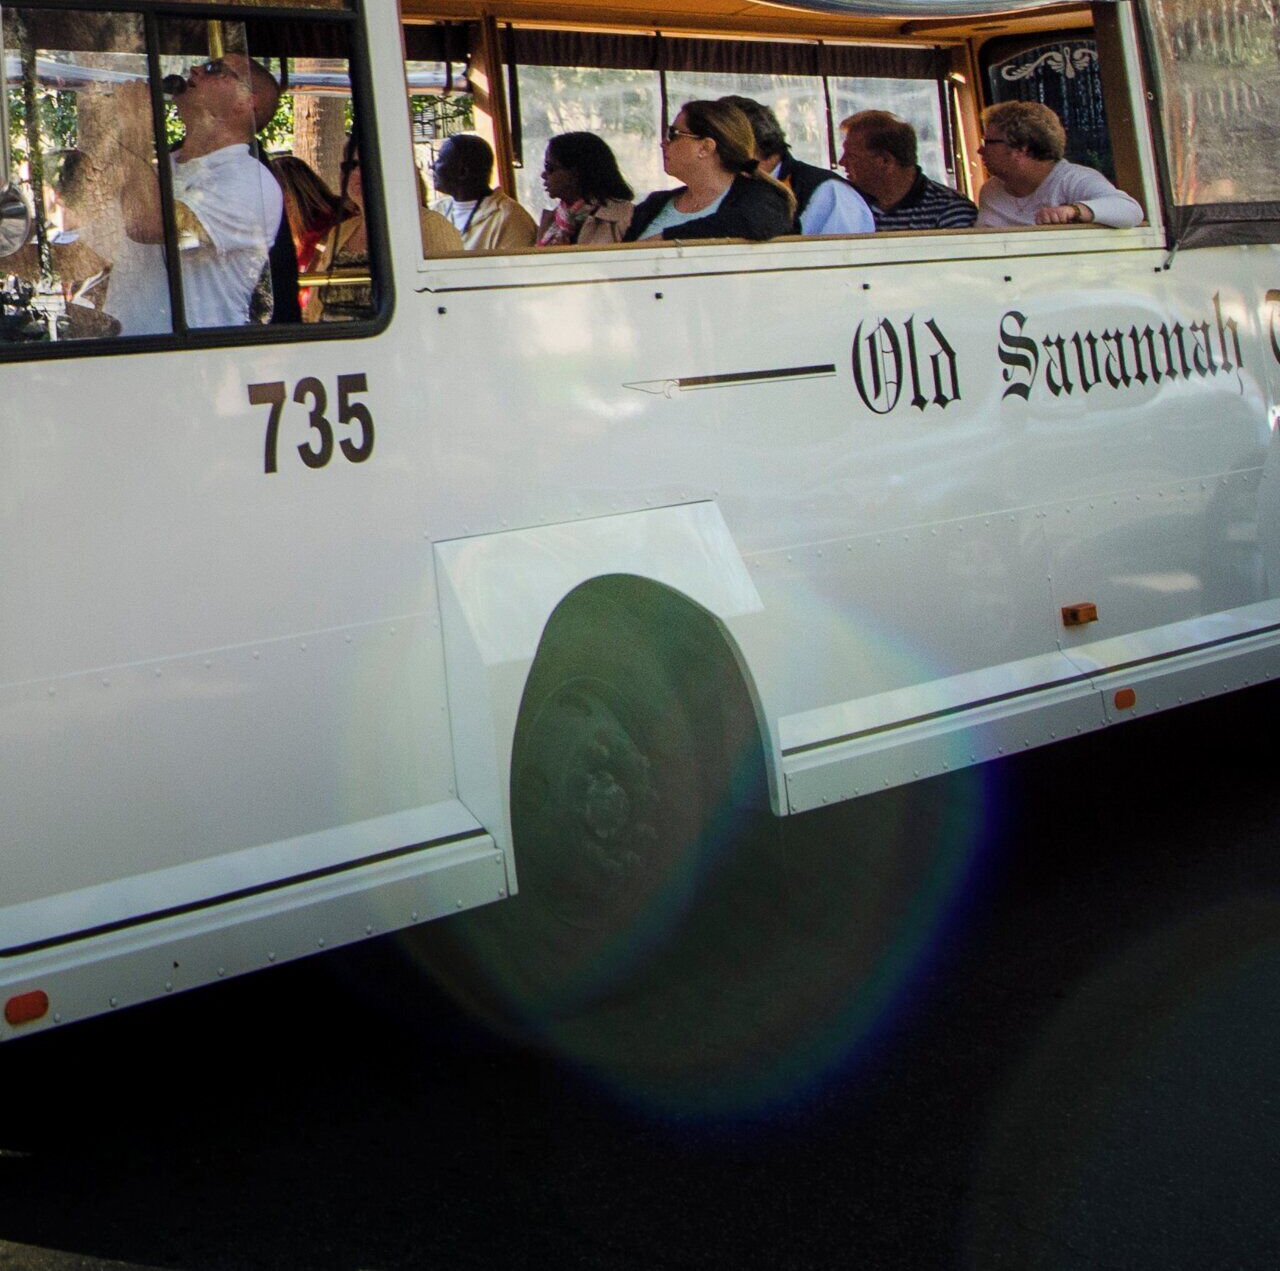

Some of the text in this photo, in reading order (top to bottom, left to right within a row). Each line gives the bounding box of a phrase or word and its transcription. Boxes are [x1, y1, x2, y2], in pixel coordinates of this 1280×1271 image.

[851, 313, 962, 415] Old
[997, 290, 1244, 402] Savannah
[247, 372, 375, 474] 735
